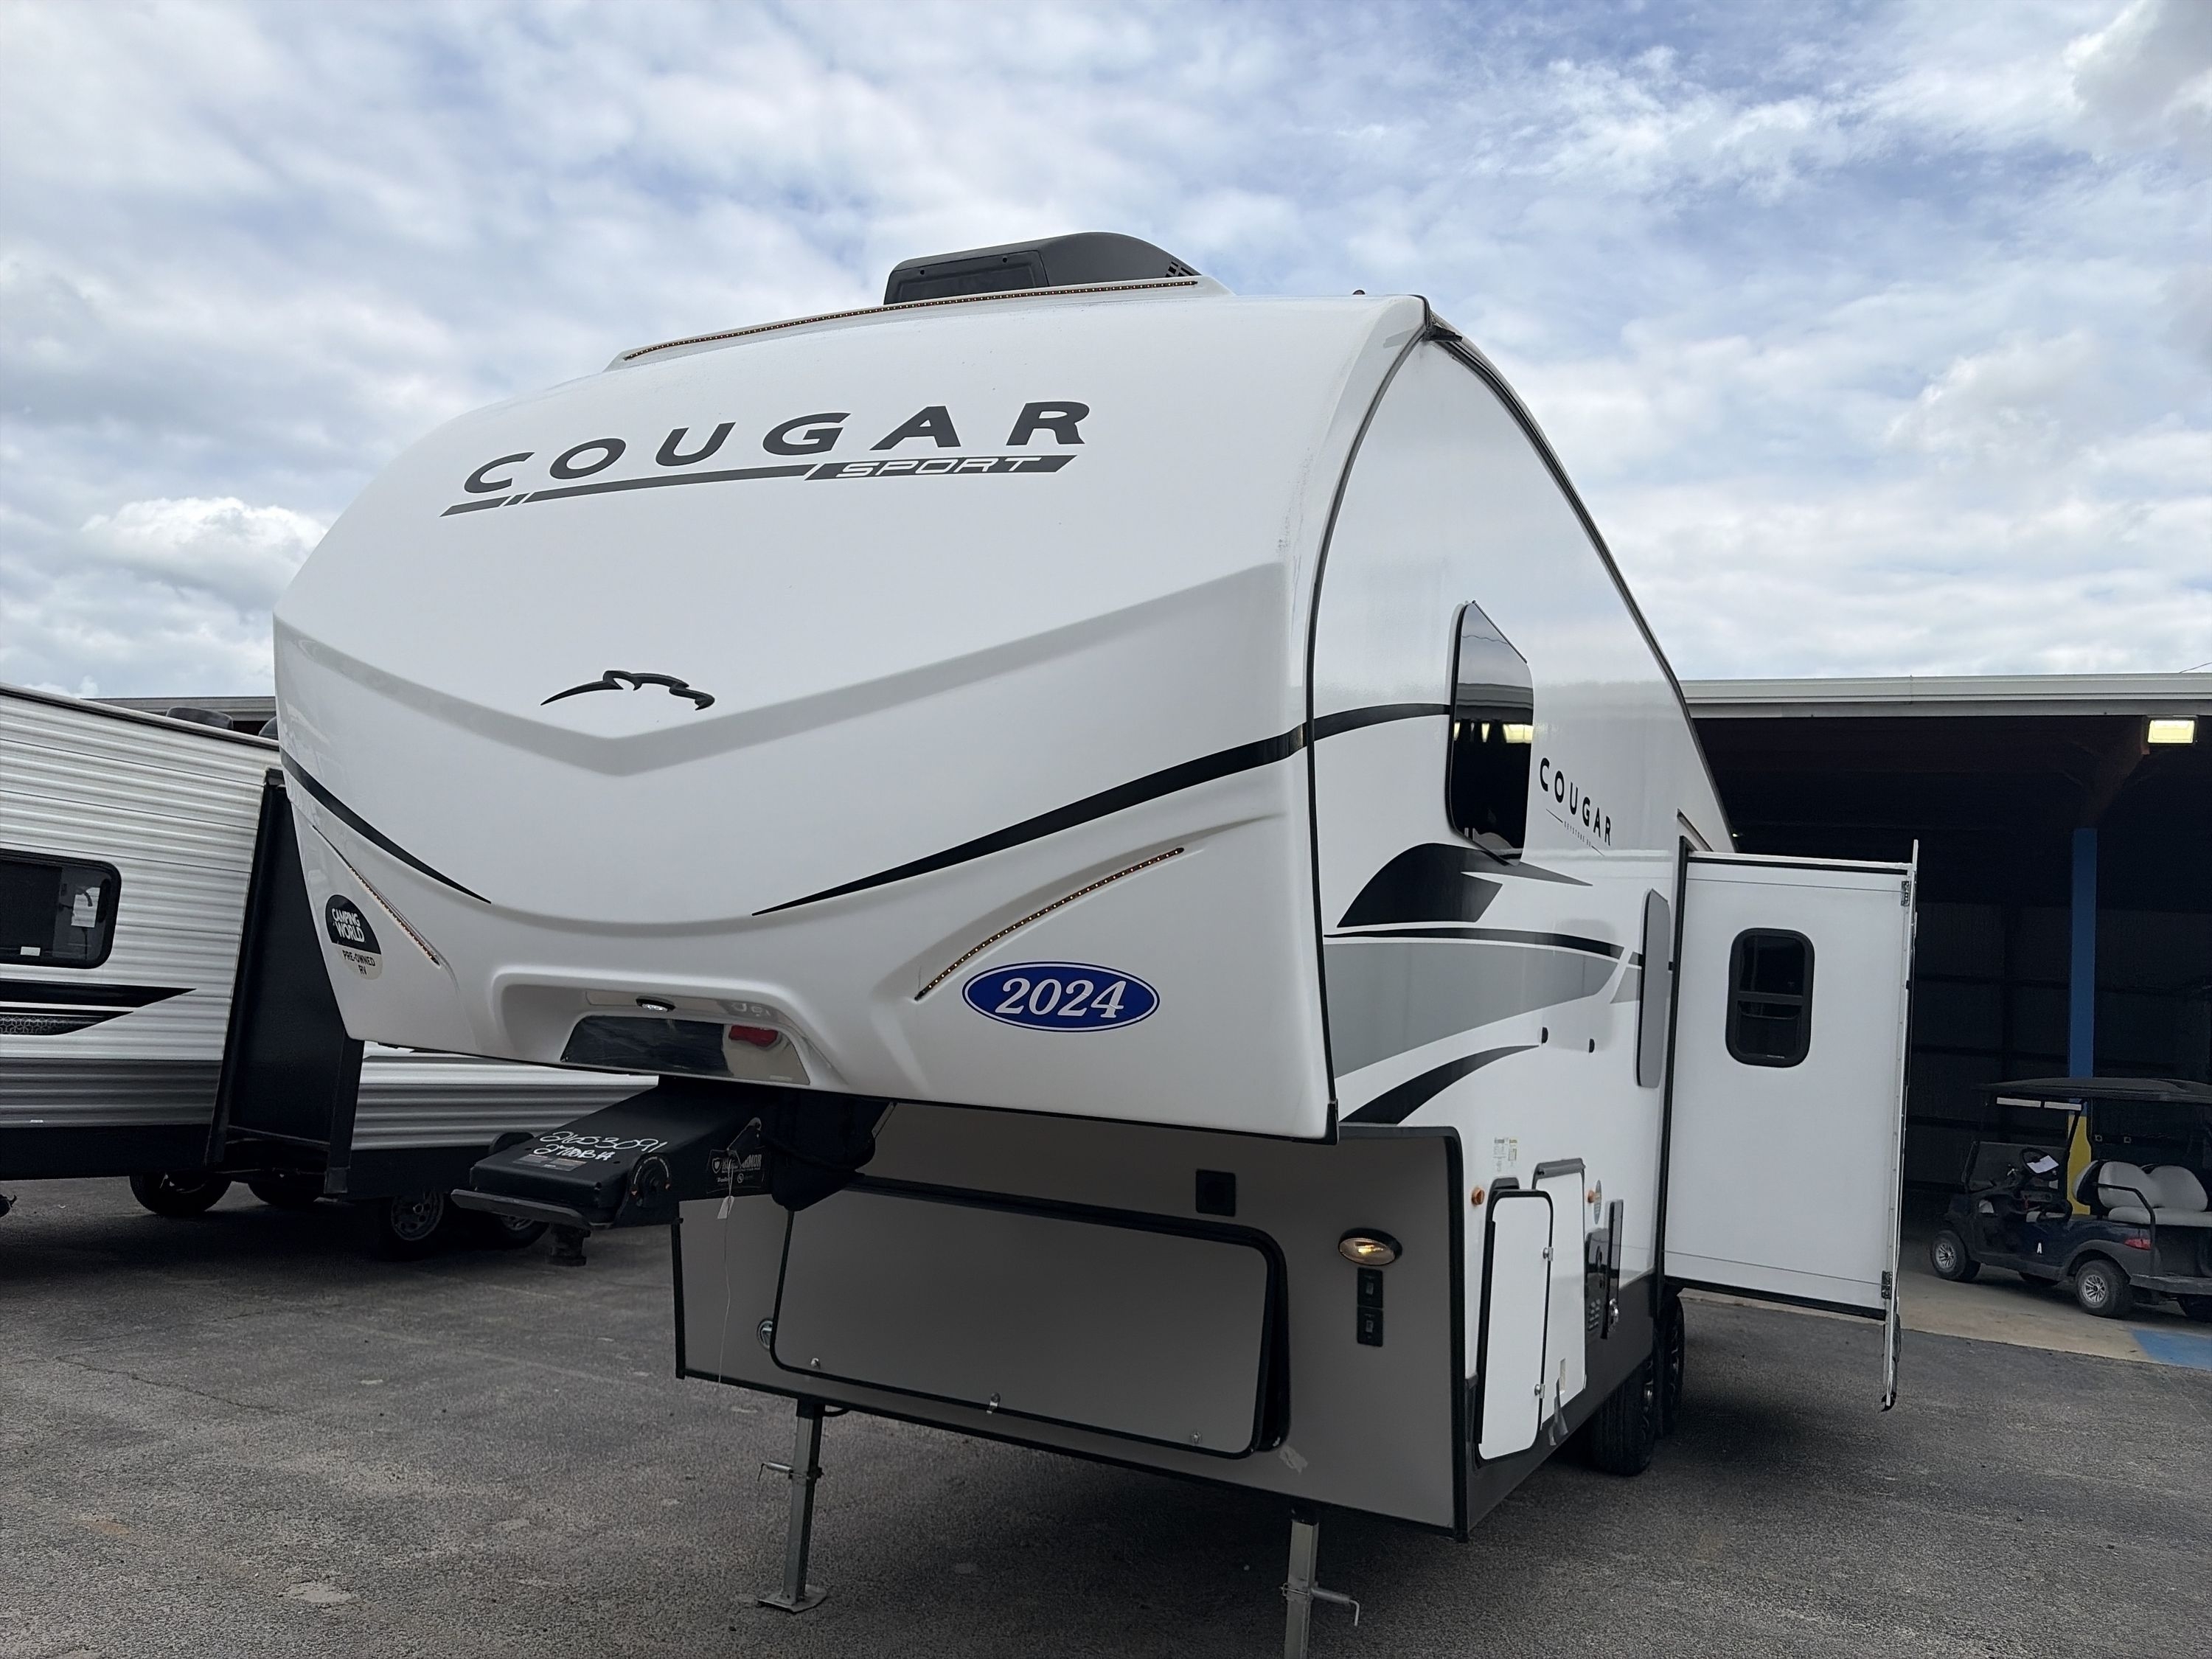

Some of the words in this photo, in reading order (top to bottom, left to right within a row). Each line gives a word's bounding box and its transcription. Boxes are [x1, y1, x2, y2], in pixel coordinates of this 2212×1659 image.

[464, 401, 1091, 493] COUGAR
[835, 457, 1042, 478] SPORT
[1540, 757, 1611, 846] COUGAR
[331, 908, 361, 927] CAMPING
[334, 922, 365, 942] WORLD
[342, 950, 376, 967] PRE-OWNED
[358, 964, 367, 975] RV
[995, 978, 1127, 1018] 2024
[2037, 1242, 2042, 1253] A
